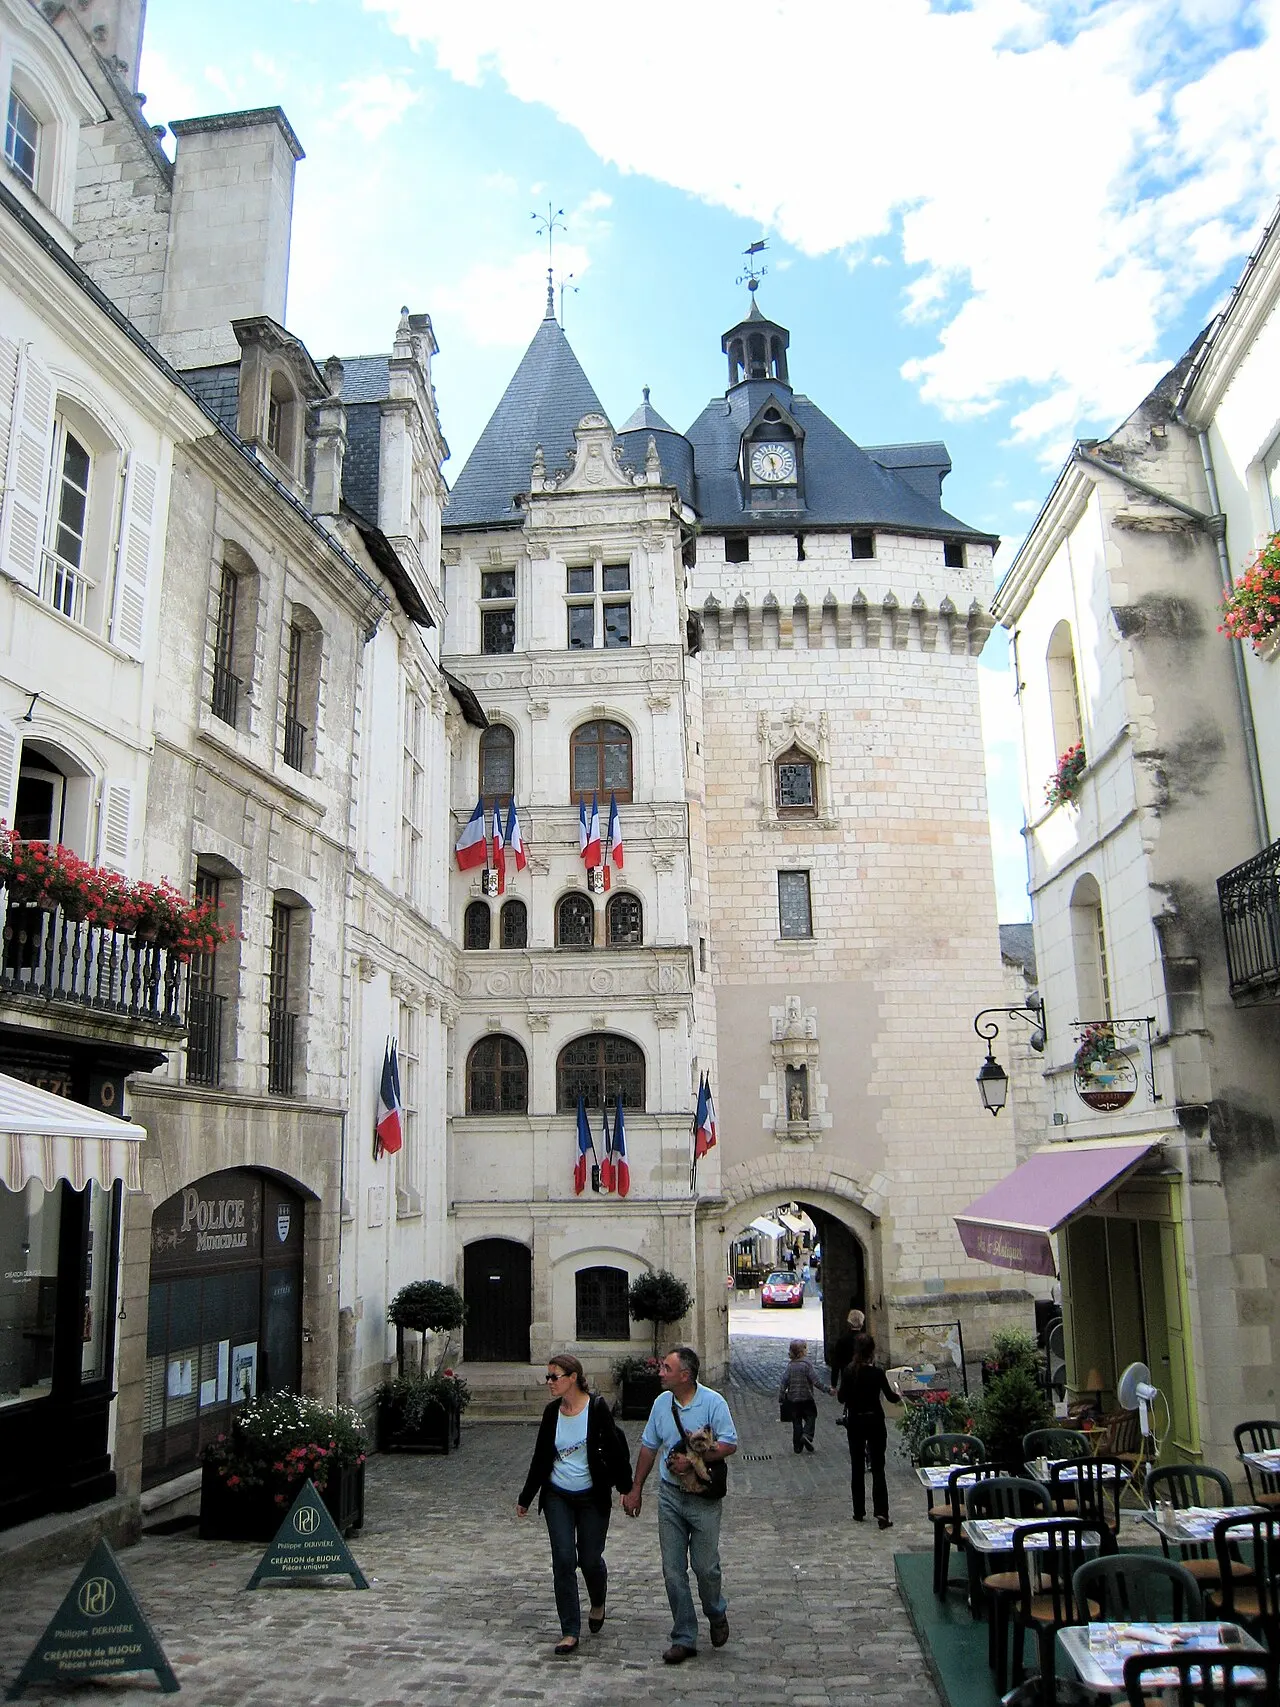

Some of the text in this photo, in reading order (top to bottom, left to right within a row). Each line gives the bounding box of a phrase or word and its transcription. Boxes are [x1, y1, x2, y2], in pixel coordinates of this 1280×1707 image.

[181, 1187, 245, 1232] POLICE
[195, 1231, 247, 1252] MUNICIPALE
[277, 1542, 302, 1550] Philippe
[270, 1554, 305, 1564] CRÉATION
[316, 1554, 341, 1562] BIJOUX
[282, 1562, 329, 1571] Pièces uniques
[55, 1629, 89, 1640] Philippe
[43, 1644, 142, 1661] CRÉATION de BIJOUX
[59, 1657, 125, 1670] Pièces uniques
